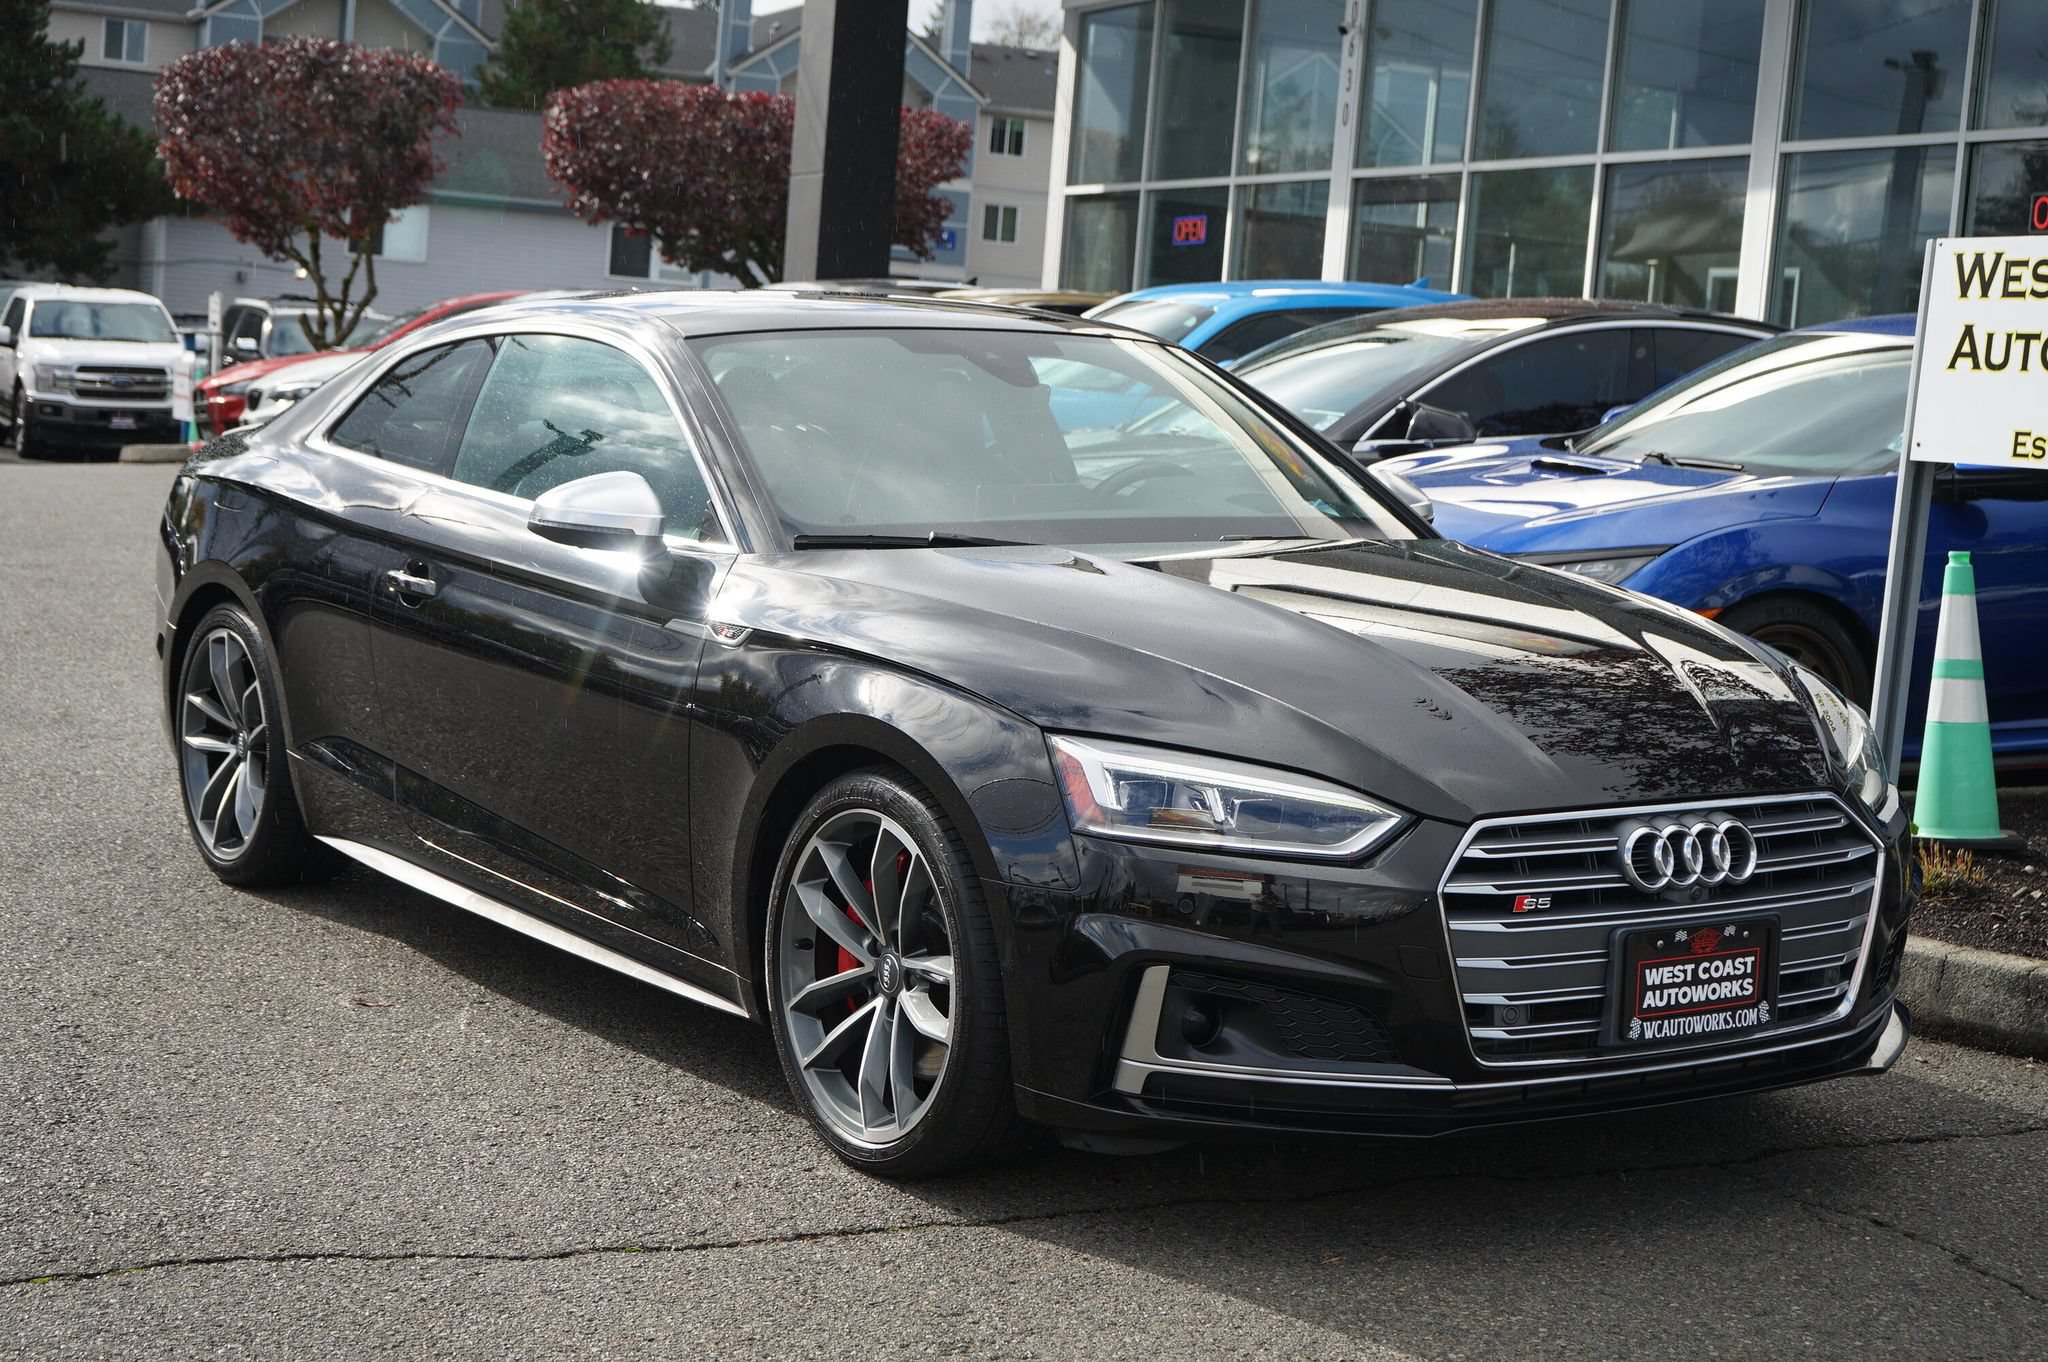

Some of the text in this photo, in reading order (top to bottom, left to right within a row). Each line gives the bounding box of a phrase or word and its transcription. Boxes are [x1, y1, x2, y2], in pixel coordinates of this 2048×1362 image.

[1947, 323, 2048, 371] AUT
[1520, 896, 1551, 910] S5
[1645, 956, 1755, 986] WEST COAST
[1642, 978, 1754, 1009] AUTOWORKS
[1643, 1007, 1758, 1039] WCAUTOWORKS.COM
